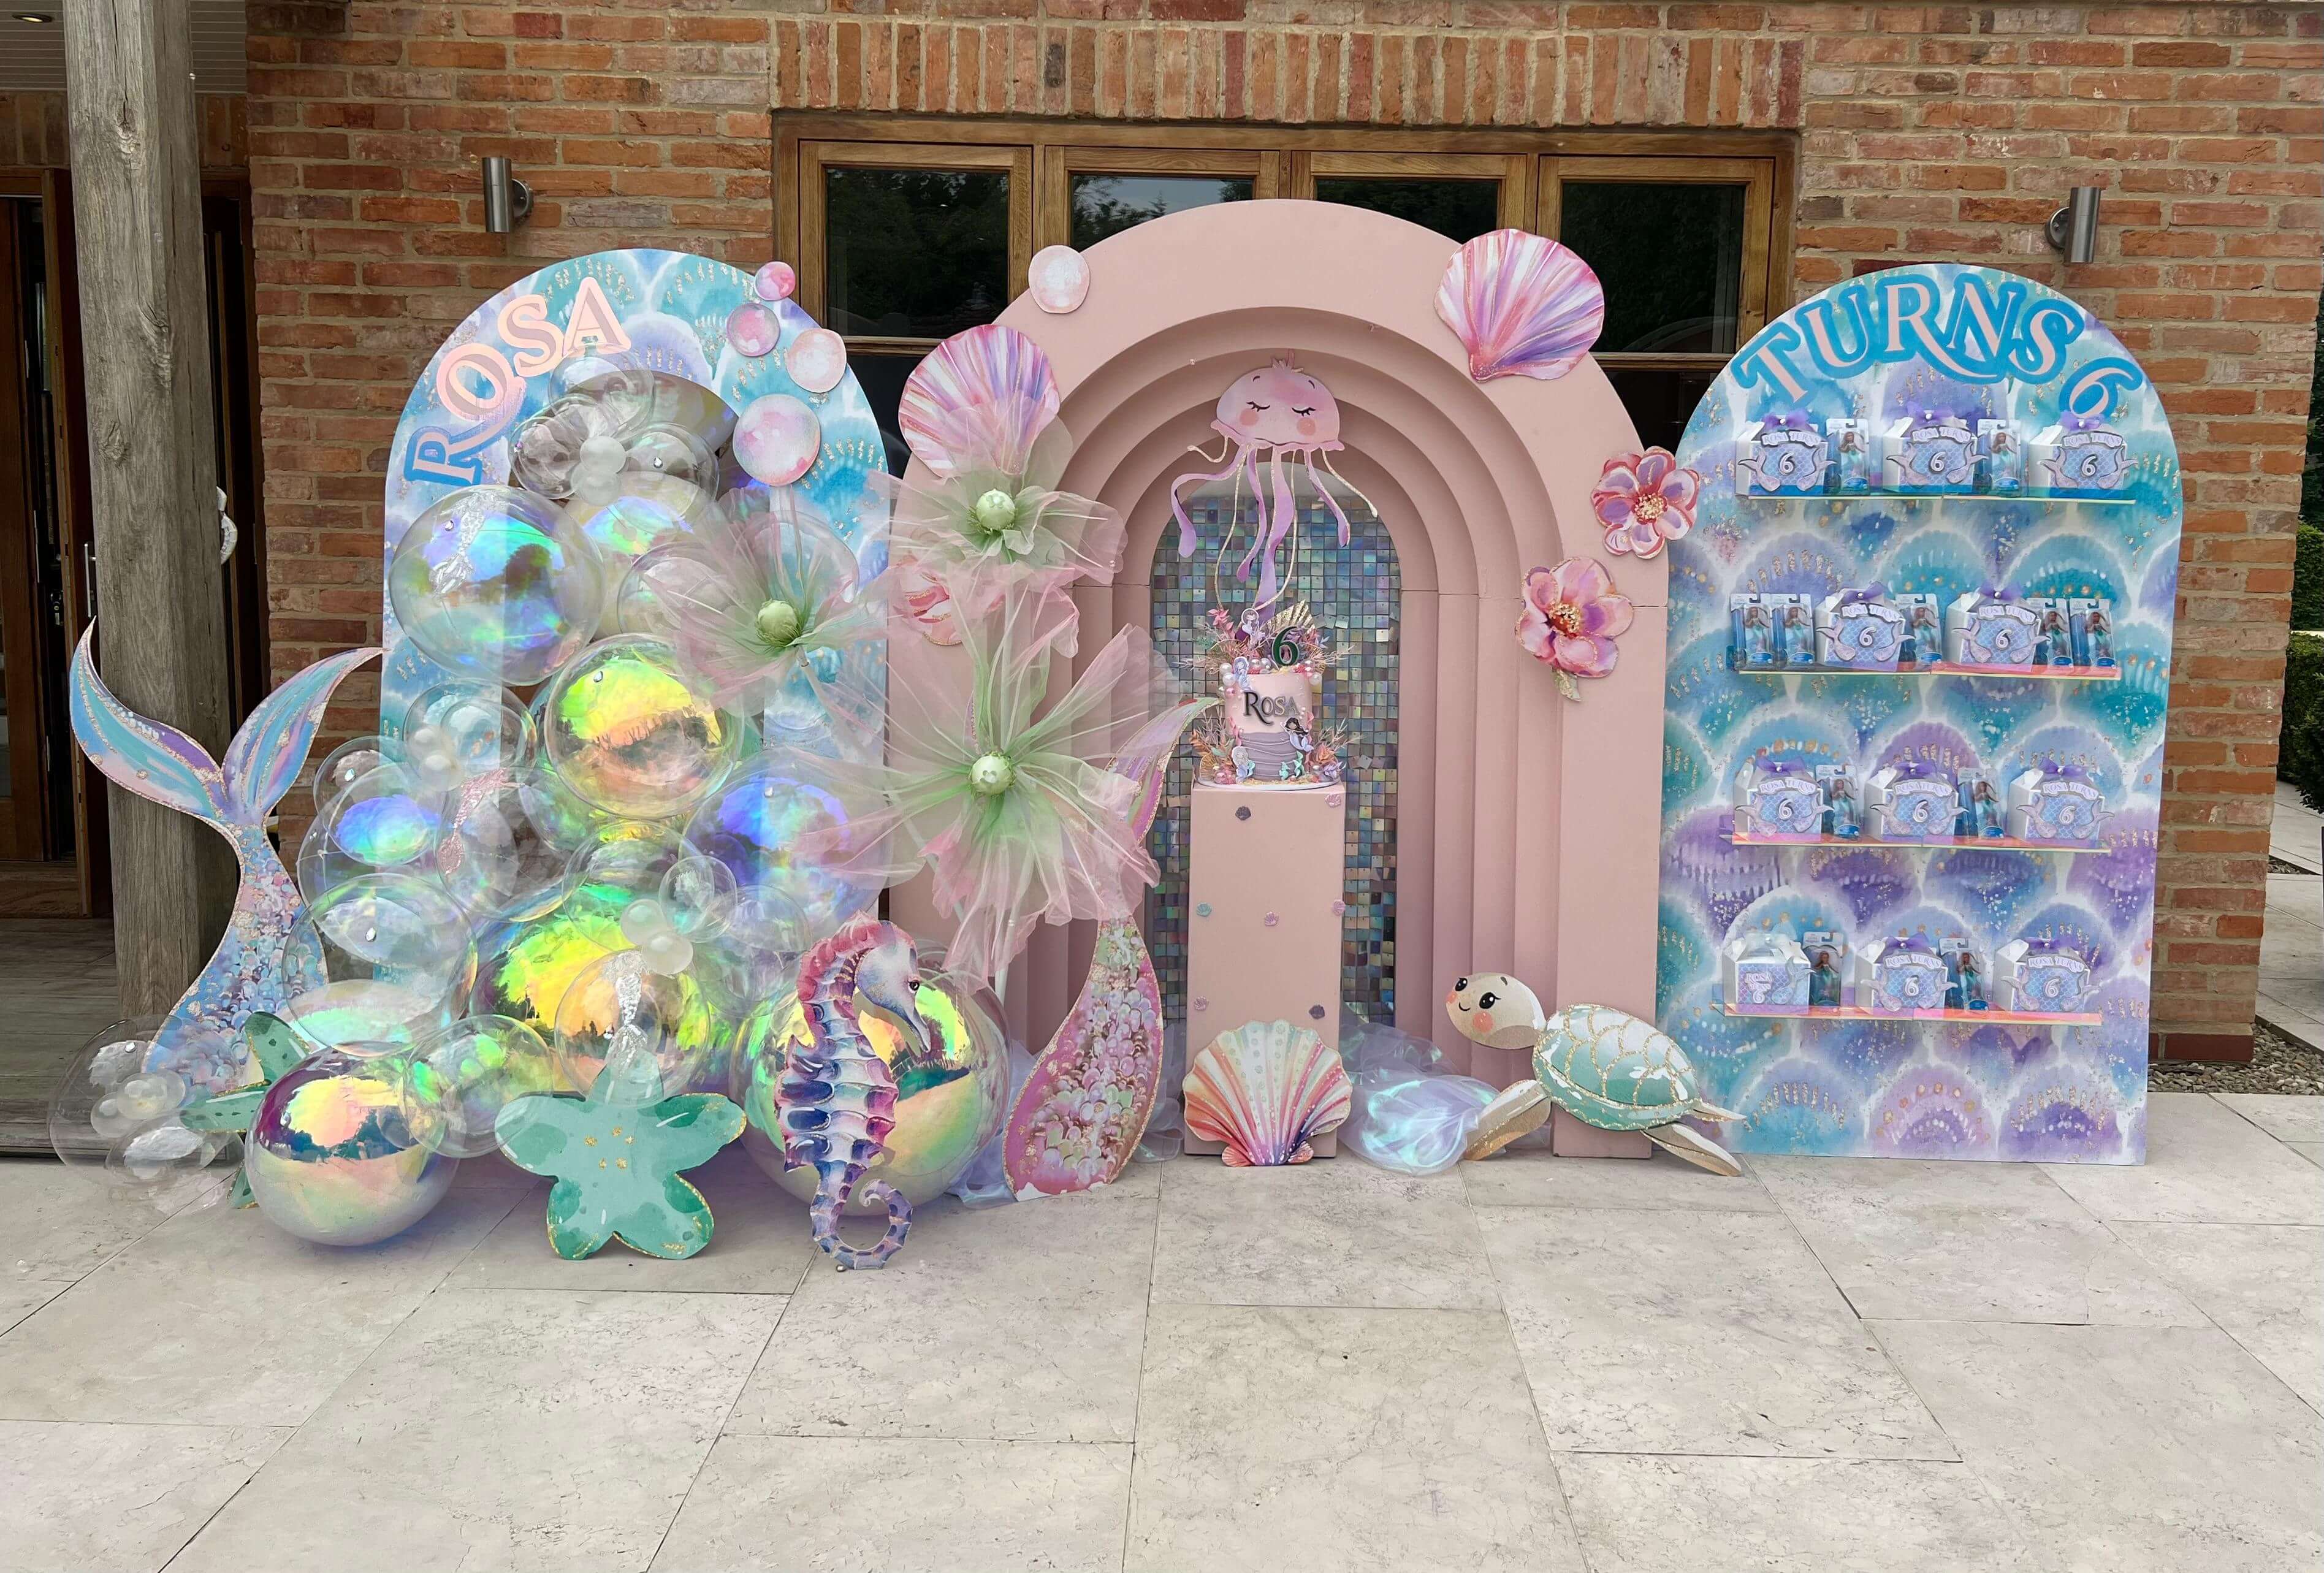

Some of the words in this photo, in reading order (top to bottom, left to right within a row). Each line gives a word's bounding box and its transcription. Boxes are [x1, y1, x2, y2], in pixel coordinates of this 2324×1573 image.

[1732, 272, 2085, 404] TURNS
[2060, 356, 2143, 420] 6
[403, 276, 631, 486] ROSA
[1779, 452, 1795, 475] 6
[1930, 451, 1946, 472] 6
[2081, 455, 2097, 476] 6
[1271, 626, 1300, 666] 6
[1859, 627, 1876, 646] 6
[1995, 628, 2013, 650] 6
[1778, 799, 1794, 820] 6
[1913, 800, 1928, 823] 6
[2059, 806, 2076, 825] 6
[1752, 989, 1766, 1004] 6
[1905, 976, 1919, 996] 6
[2044, 977, 2060, 998] 6
